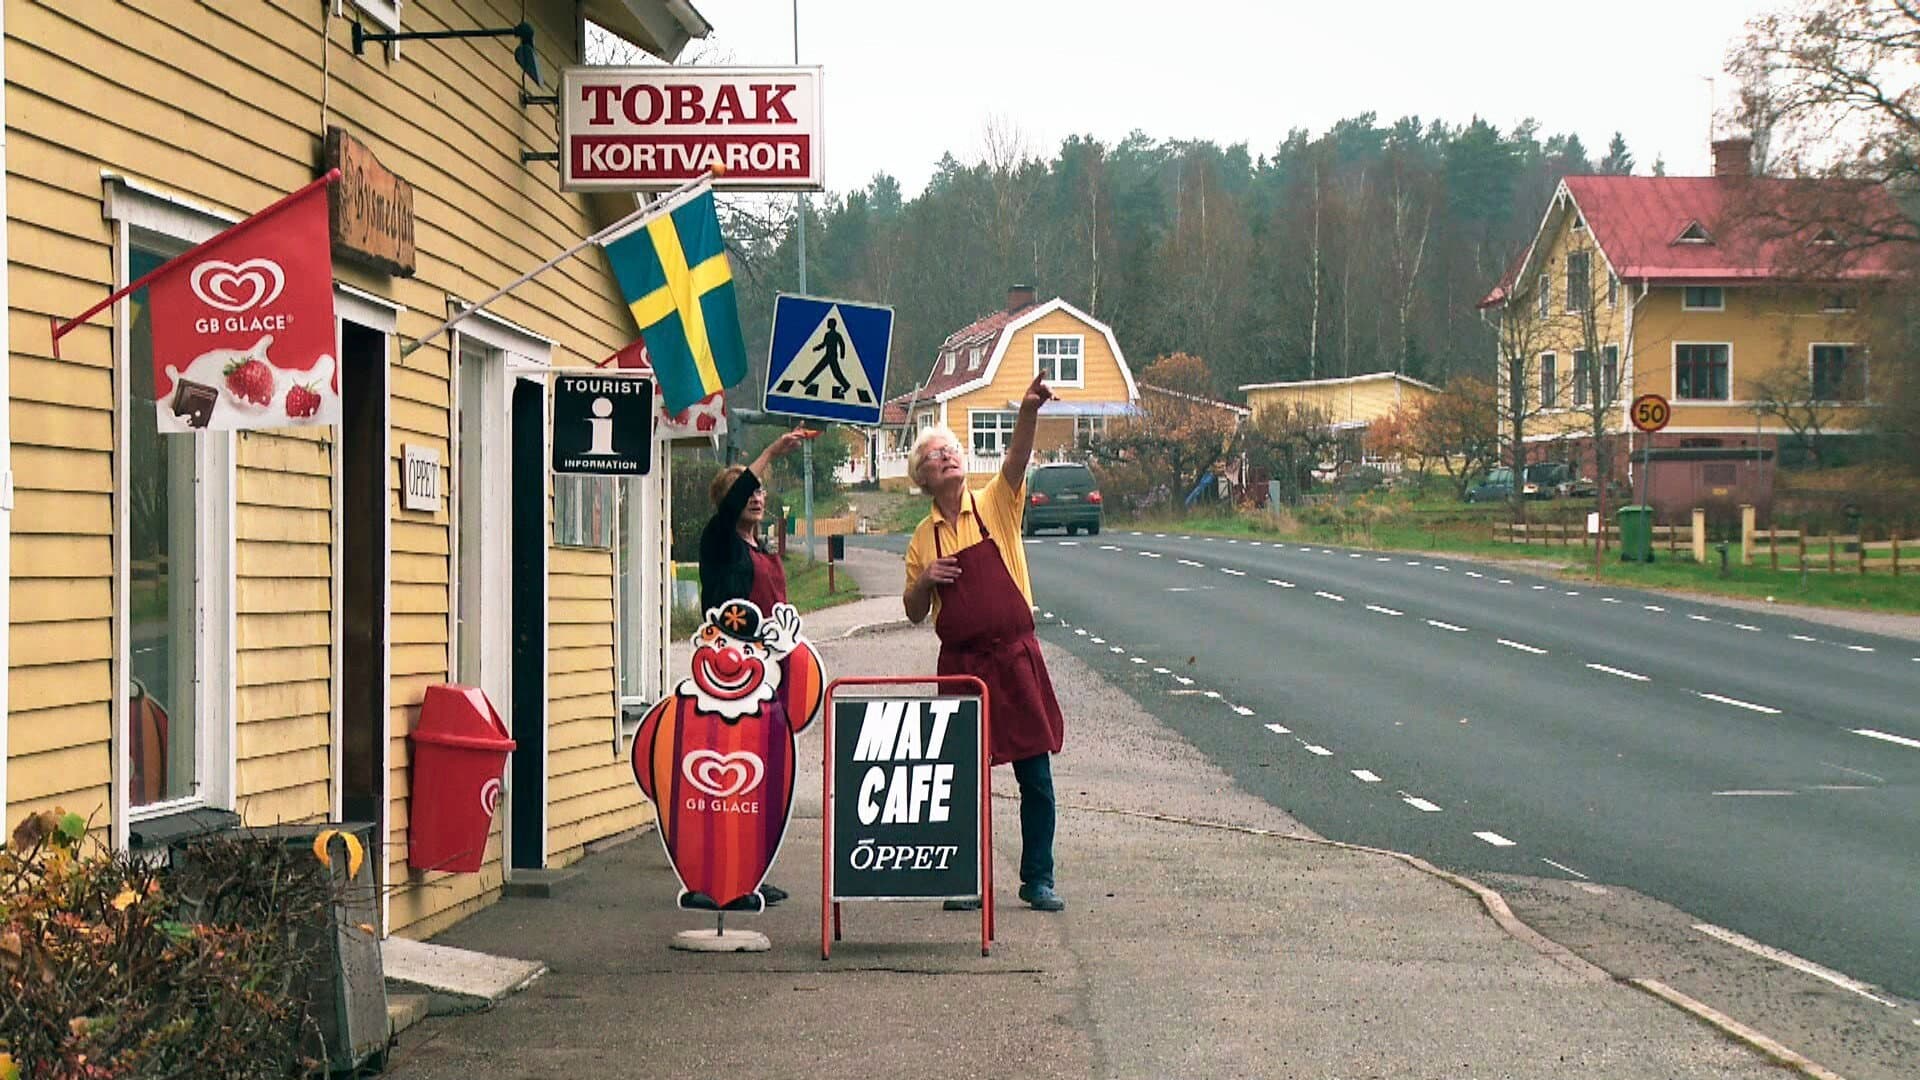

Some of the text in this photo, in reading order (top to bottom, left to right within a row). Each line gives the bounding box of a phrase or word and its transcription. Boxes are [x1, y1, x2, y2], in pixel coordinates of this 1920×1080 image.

[581, 84, 798, 125] TOBAK
[582, 142, 801, 171] KORTVAROR
[195, 318, 220, 333] GB
[564, 380, 643, 395] TOURIST
[1639, 404, 1665, 423] 50
[407, 452, 438, 499] ÖPPET
[564, 459, 637, 470] INFORMATION
[853, 700, 960, 761] MAT
[686, 798, 759, 814] GB GLACE
[857, 764, 954, 826] CAFE
